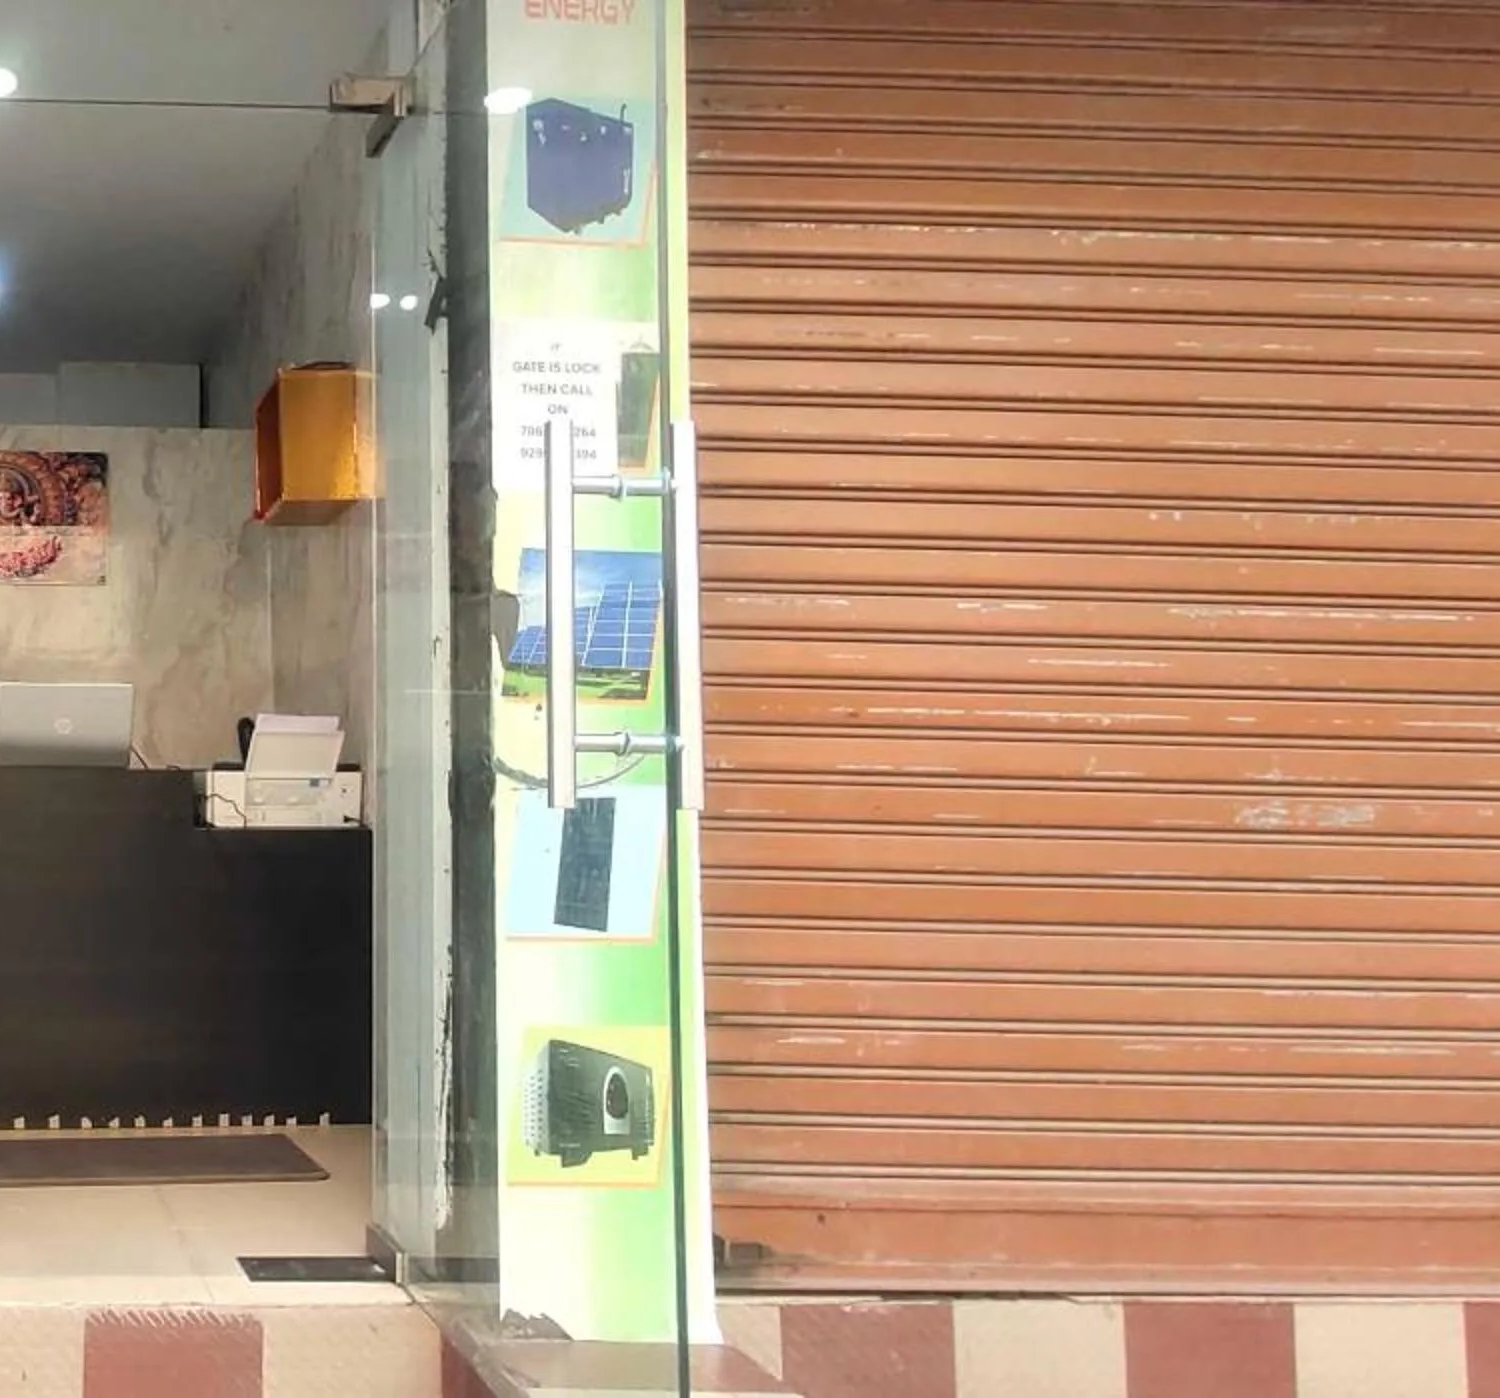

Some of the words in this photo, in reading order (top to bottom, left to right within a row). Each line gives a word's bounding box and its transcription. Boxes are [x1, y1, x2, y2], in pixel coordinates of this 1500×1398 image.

[524, 0, 636, 25] ENERGY
[512, 360, 546, 373] GATE
[549, 361, 561, 373] IS
[565, 362, 601, 374] LOCK
[522, 383, 557, 395] THEN
[560, 384, 593, 396] CALL
[547, 404, 569, 415] ON
